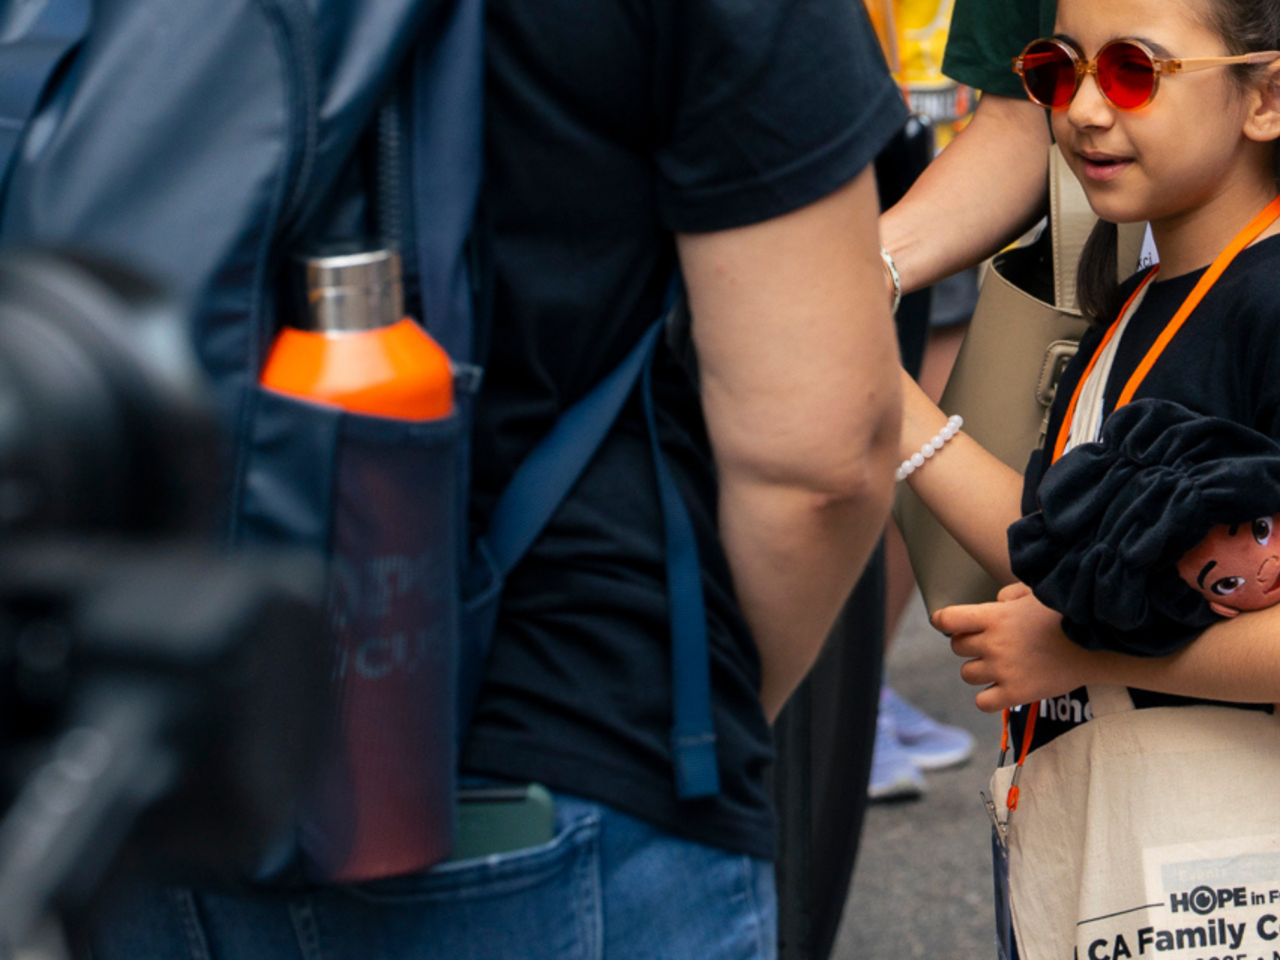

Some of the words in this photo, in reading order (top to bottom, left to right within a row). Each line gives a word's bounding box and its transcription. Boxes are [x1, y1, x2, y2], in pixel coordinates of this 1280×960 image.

[1169, 885, 1248, 915] HOPE
[1250, 891, 1265, 905] in
[1137, 918, 1246, 956] Family
